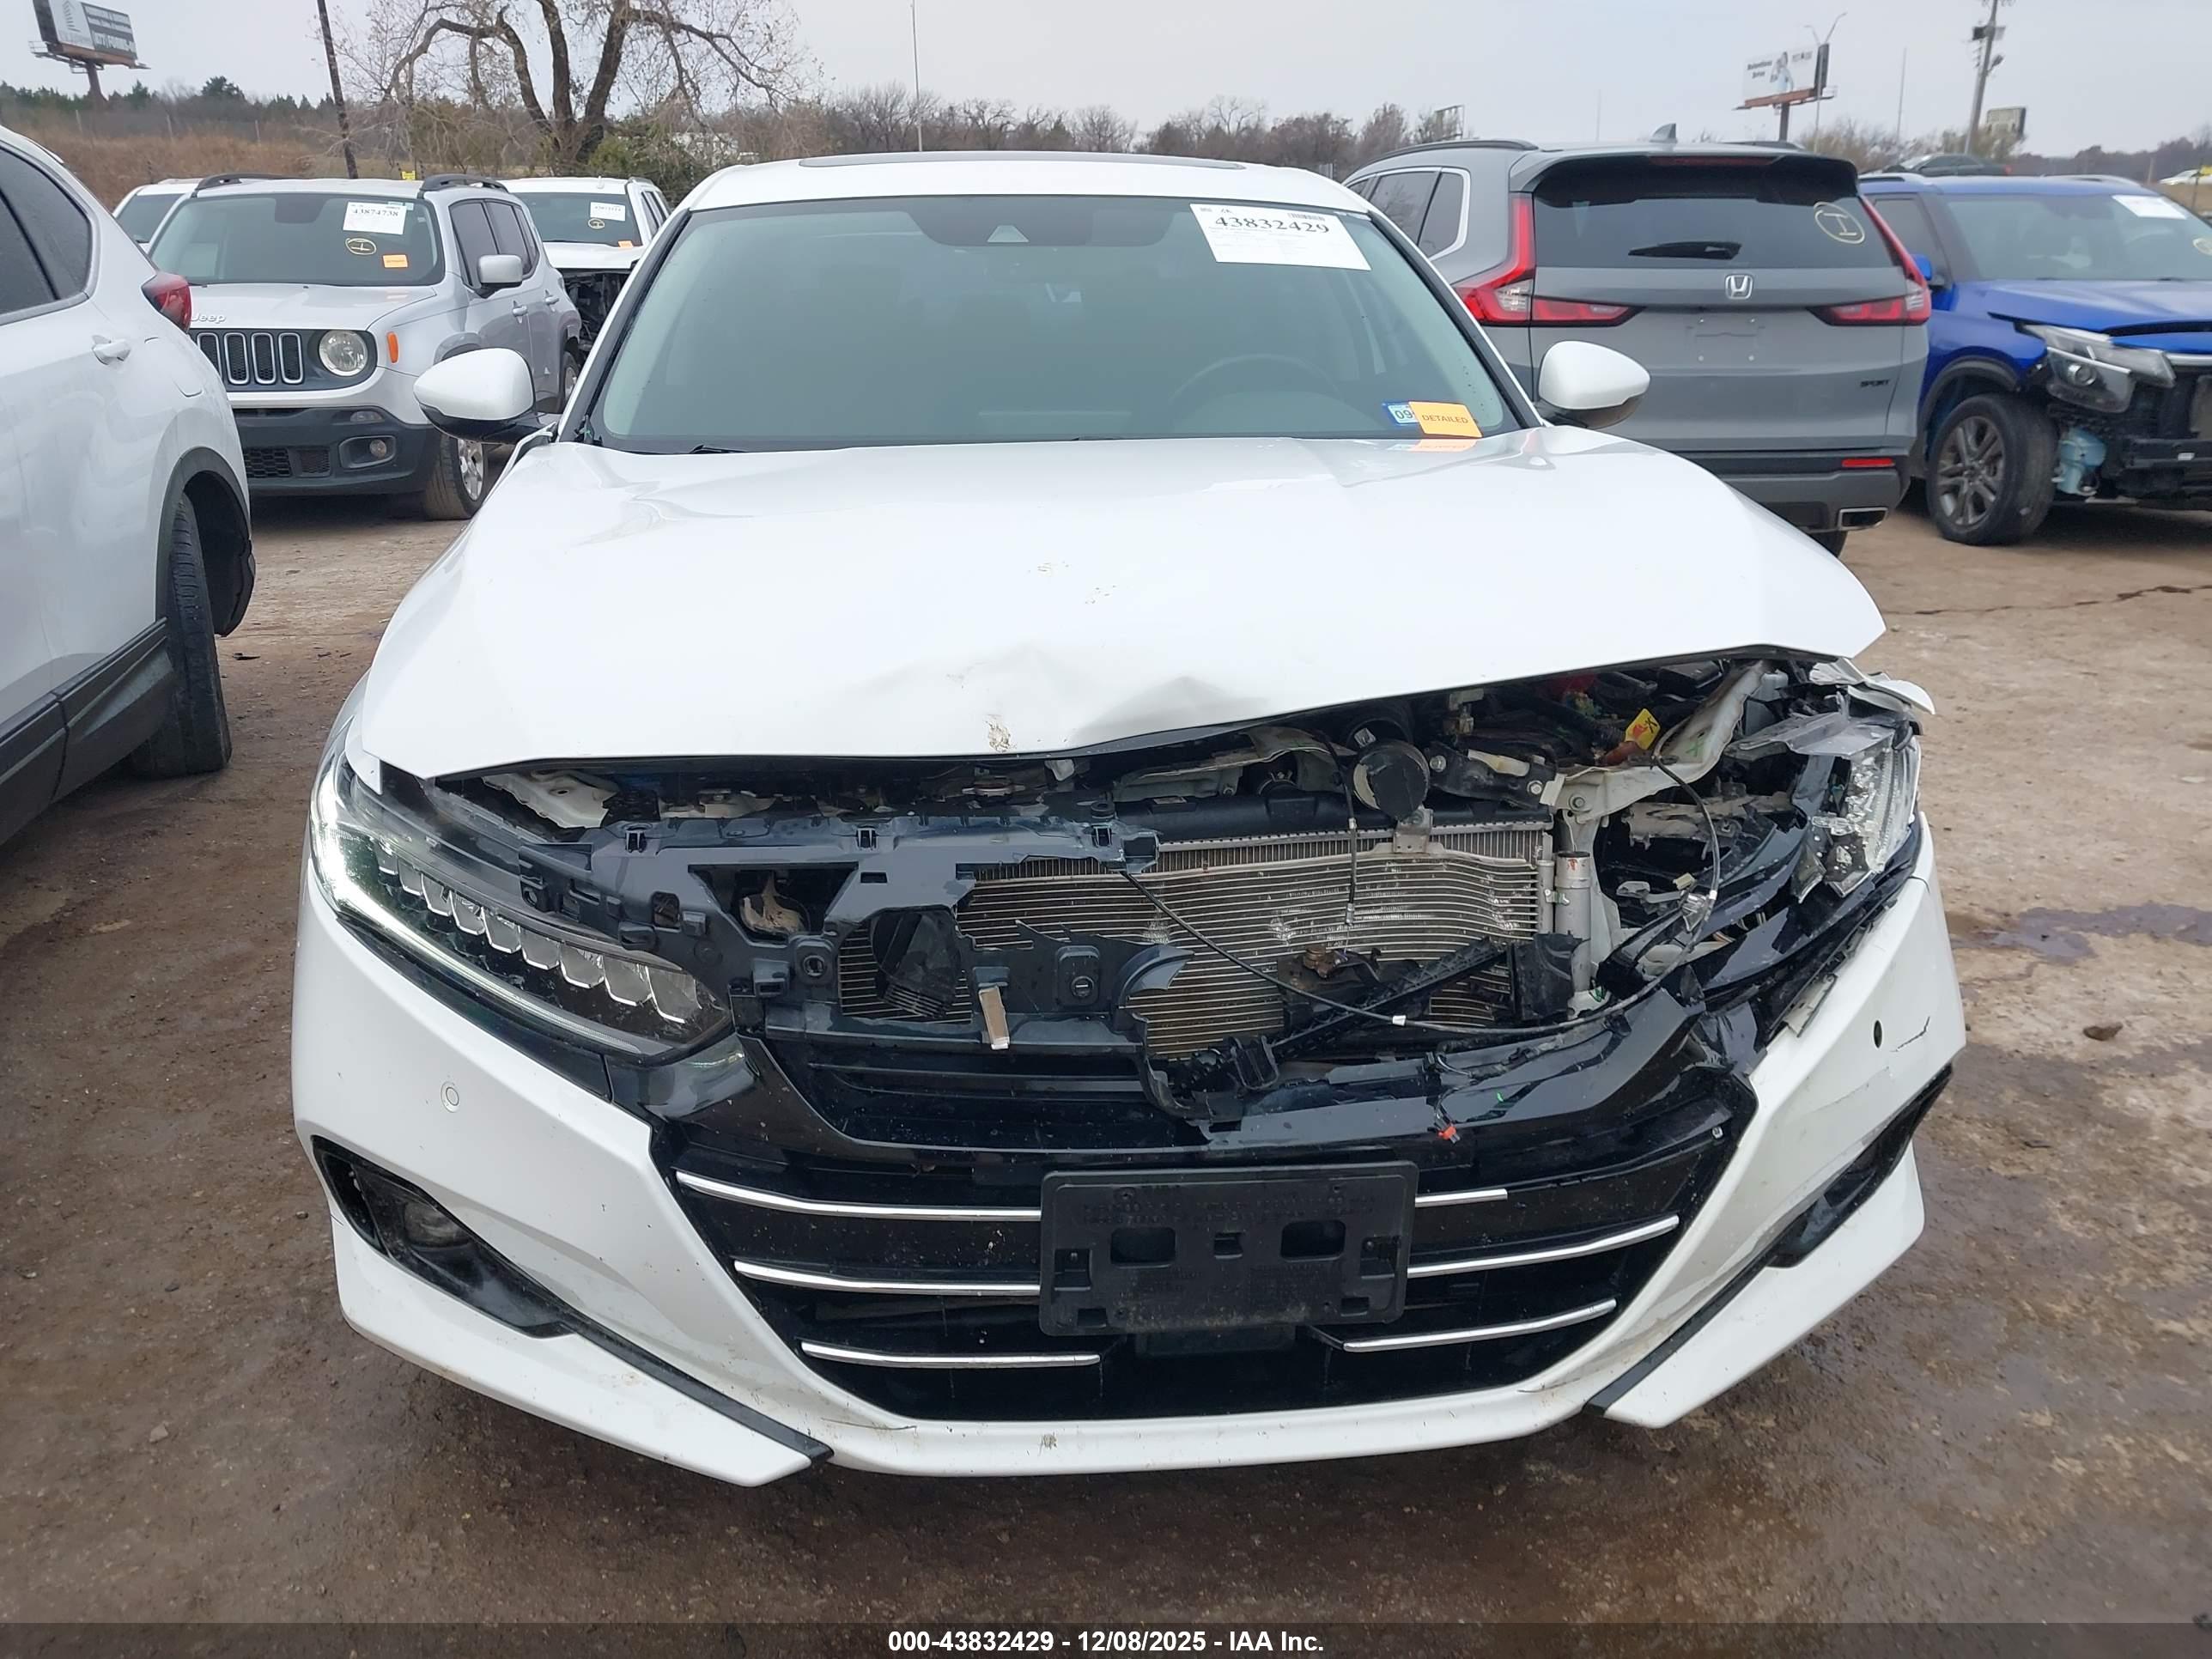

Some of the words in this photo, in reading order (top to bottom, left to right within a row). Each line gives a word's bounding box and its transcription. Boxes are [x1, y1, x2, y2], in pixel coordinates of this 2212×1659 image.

[1215, 216, 1330, 234] 43832429
[191, 312, 227, 325] Jeep
[1395, 410, 1413, 420] 09
[1421, 414, 1469, 424] DETAILED
